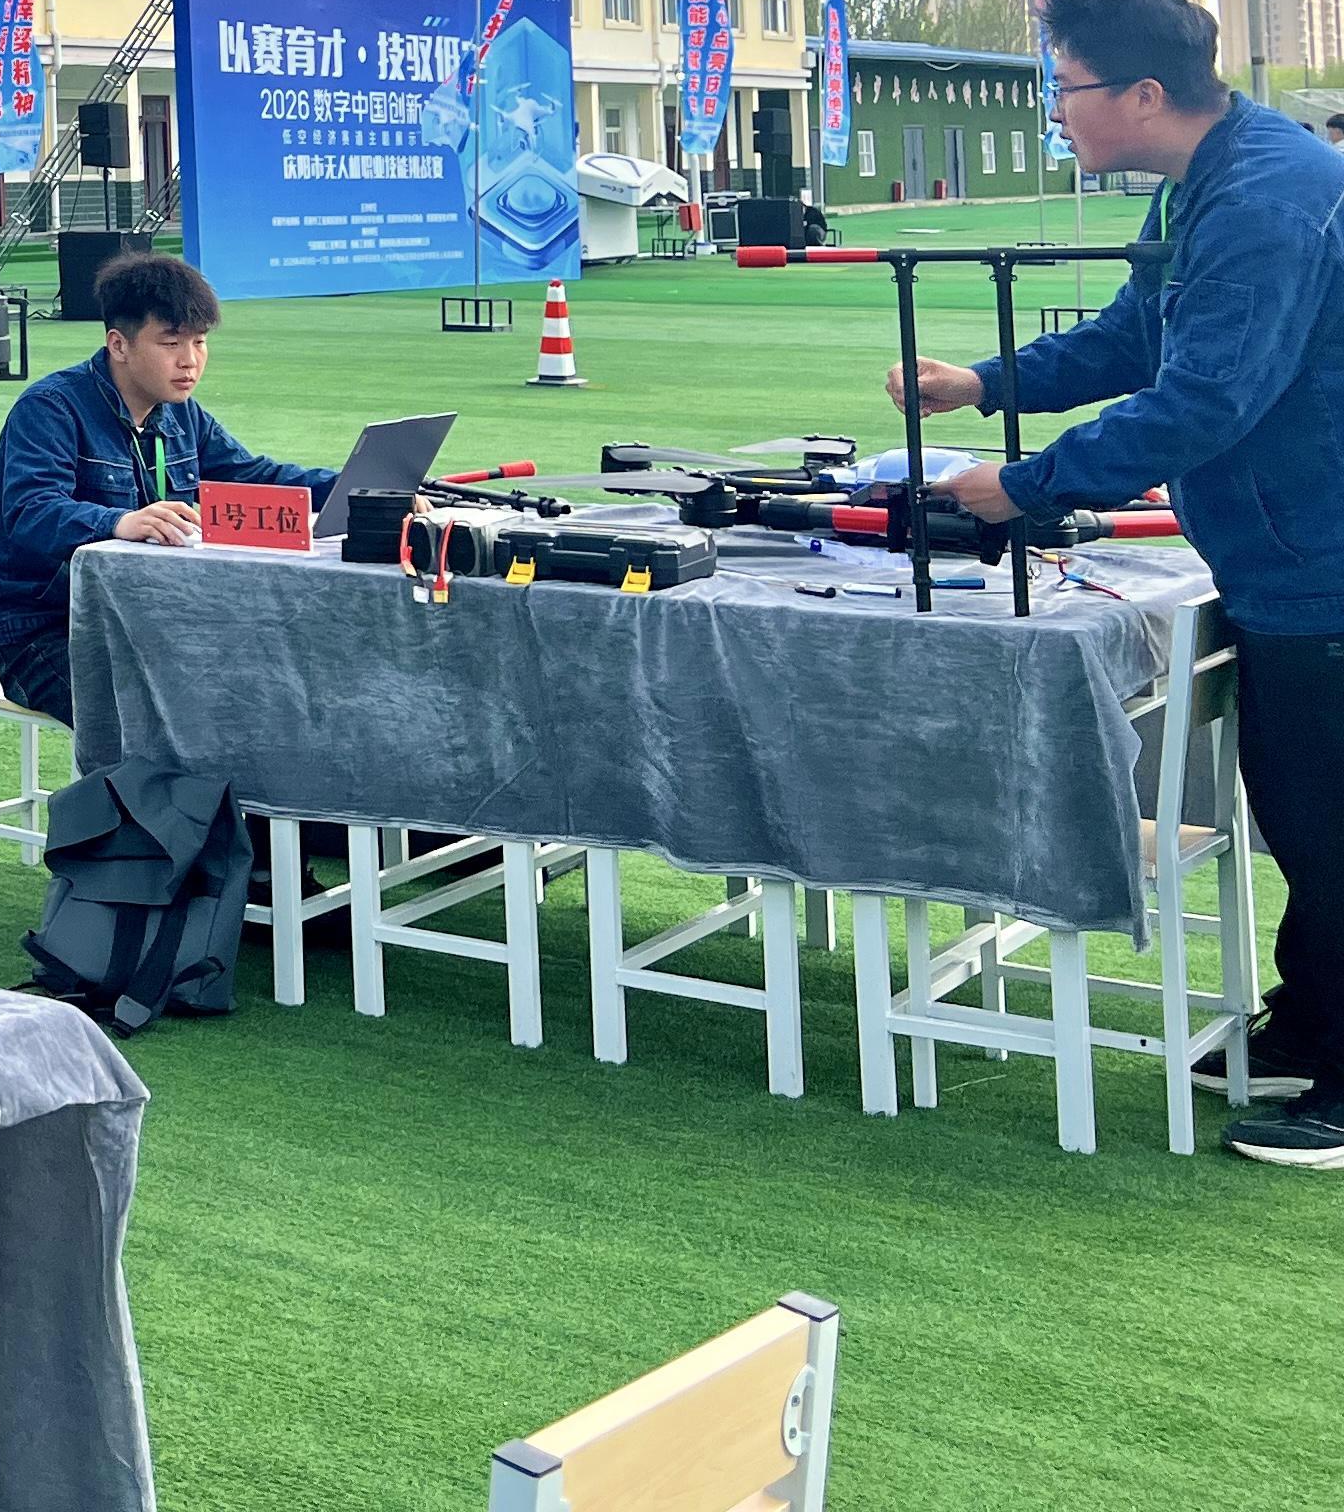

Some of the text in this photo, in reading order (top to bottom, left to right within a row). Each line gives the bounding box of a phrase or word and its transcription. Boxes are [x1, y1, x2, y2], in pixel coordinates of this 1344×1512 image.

[218, 19, 476, 83] 以赛育才·技驭低
[209, 502, 302, 534] 1号工位
